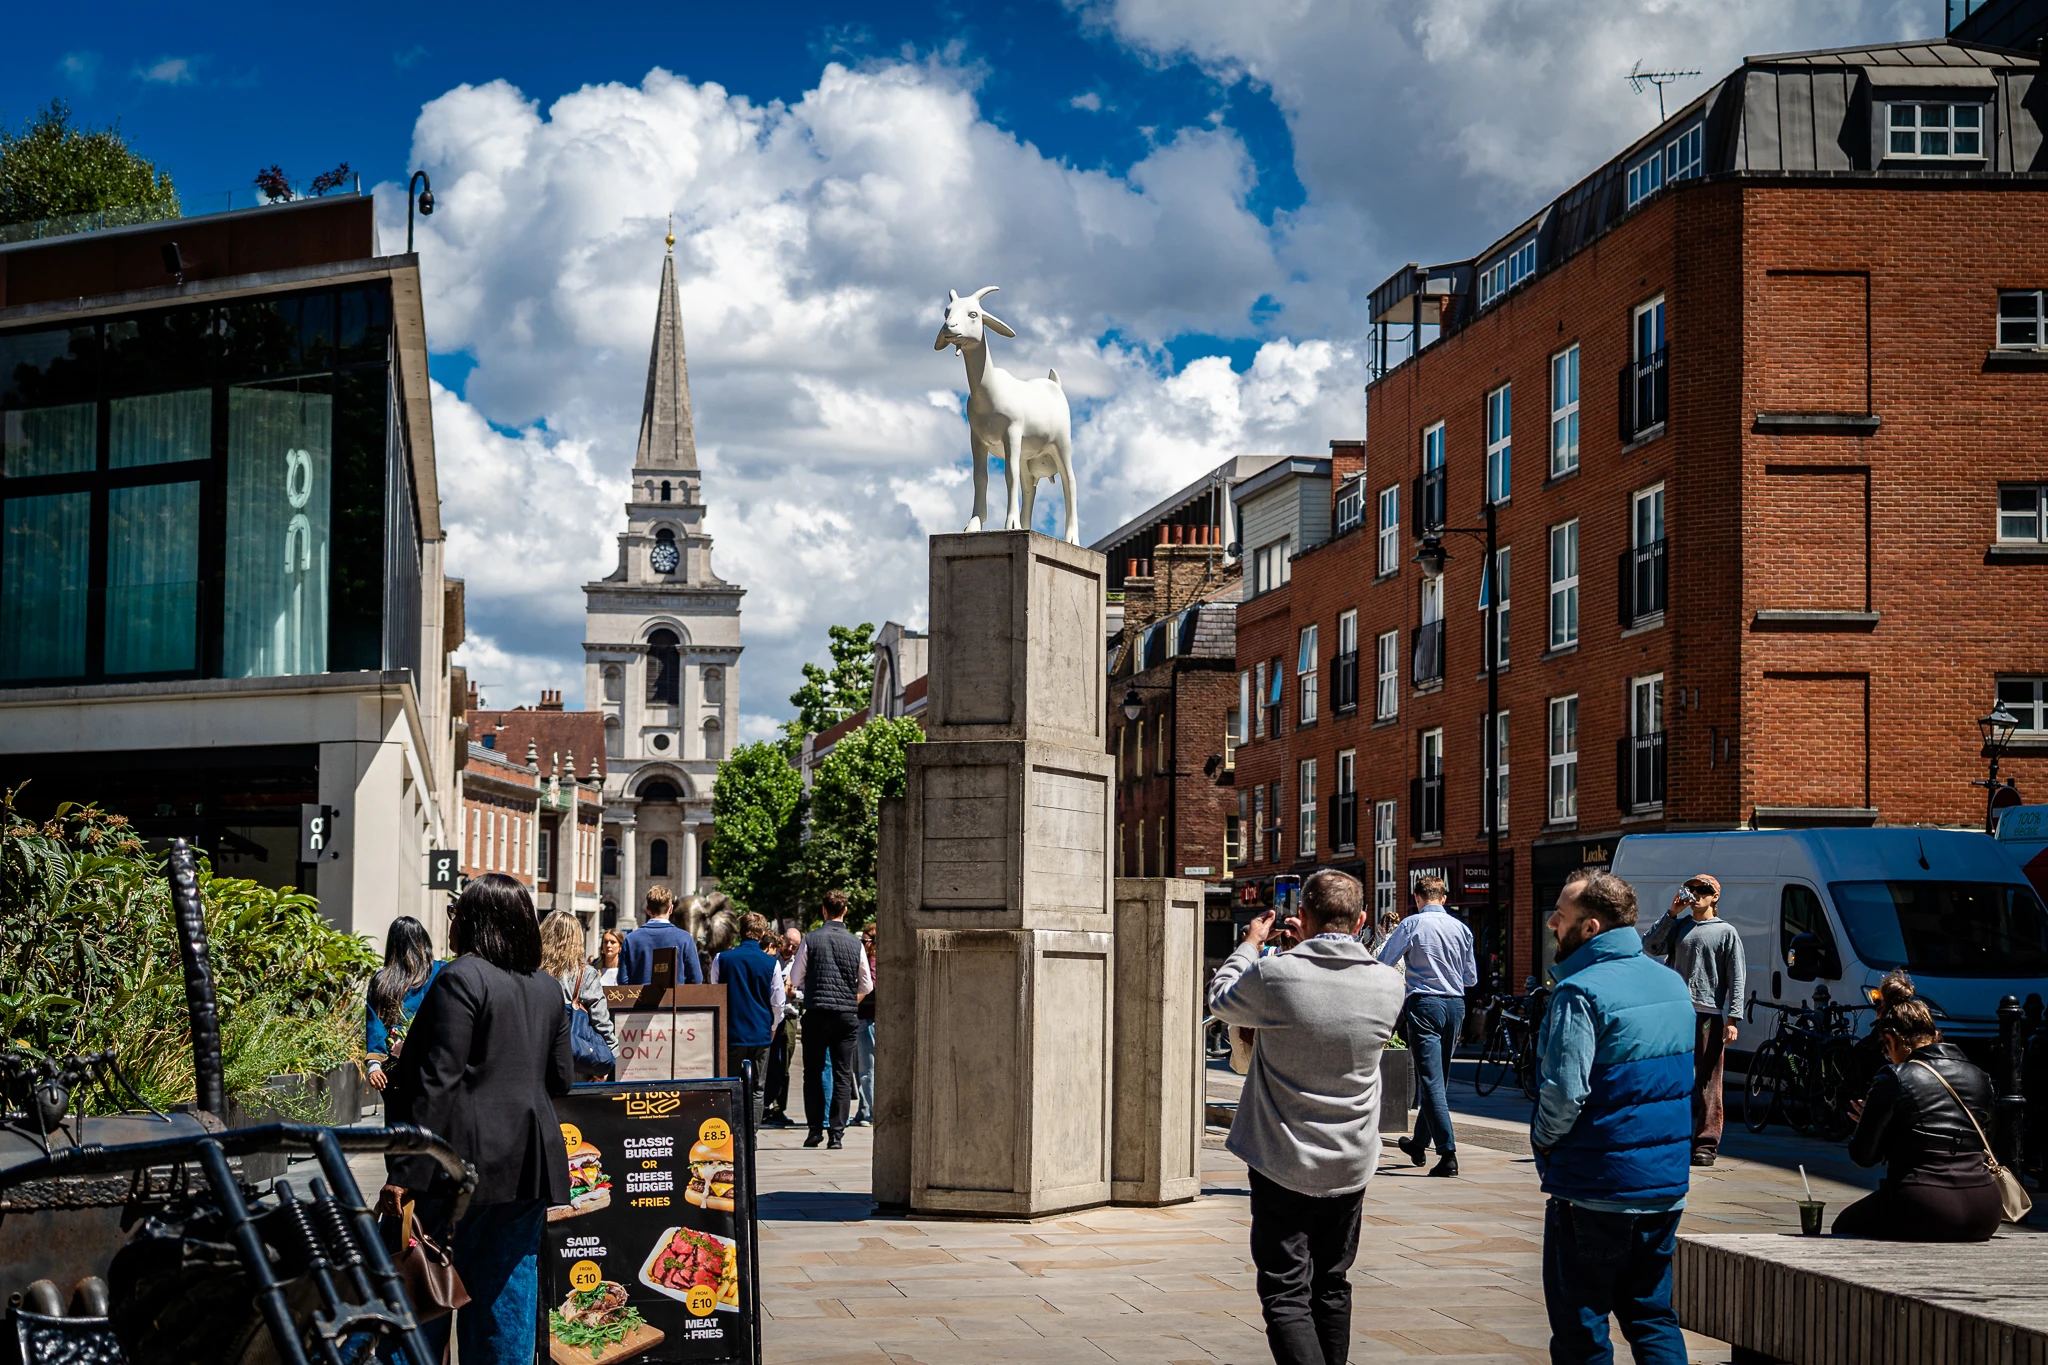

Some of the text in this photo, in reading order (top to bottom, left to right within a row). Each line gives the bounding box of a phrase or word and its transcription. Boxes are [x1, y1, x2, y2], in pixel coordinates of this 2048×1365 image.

[1582, 844, 1608, 863] Loake
[1464, 868, 1489, 877] TORTIL
[621, 1046, 649, 1060] ON
[563, 1136, 577, 1146] 8.5
[704, 1130, 727, 1141] £8.5
[623, 1136, 674, 1148] CLASSIC
[625, 1147, 673, 1159] BURGER
[641, 1160, 658, 1169] OR
[626, 1171, 673, 1183] CHEESE
[626, 1181, 674, 1193] BURGER
[566, 1236, 600, 1247] SAND
[560, 1246, 608, 1258] WICHES
[576, 1273, 596, 1284] £10
[692, 1298, 712, 1309] £10
[685, 1317, 719, 1329] MEAT
